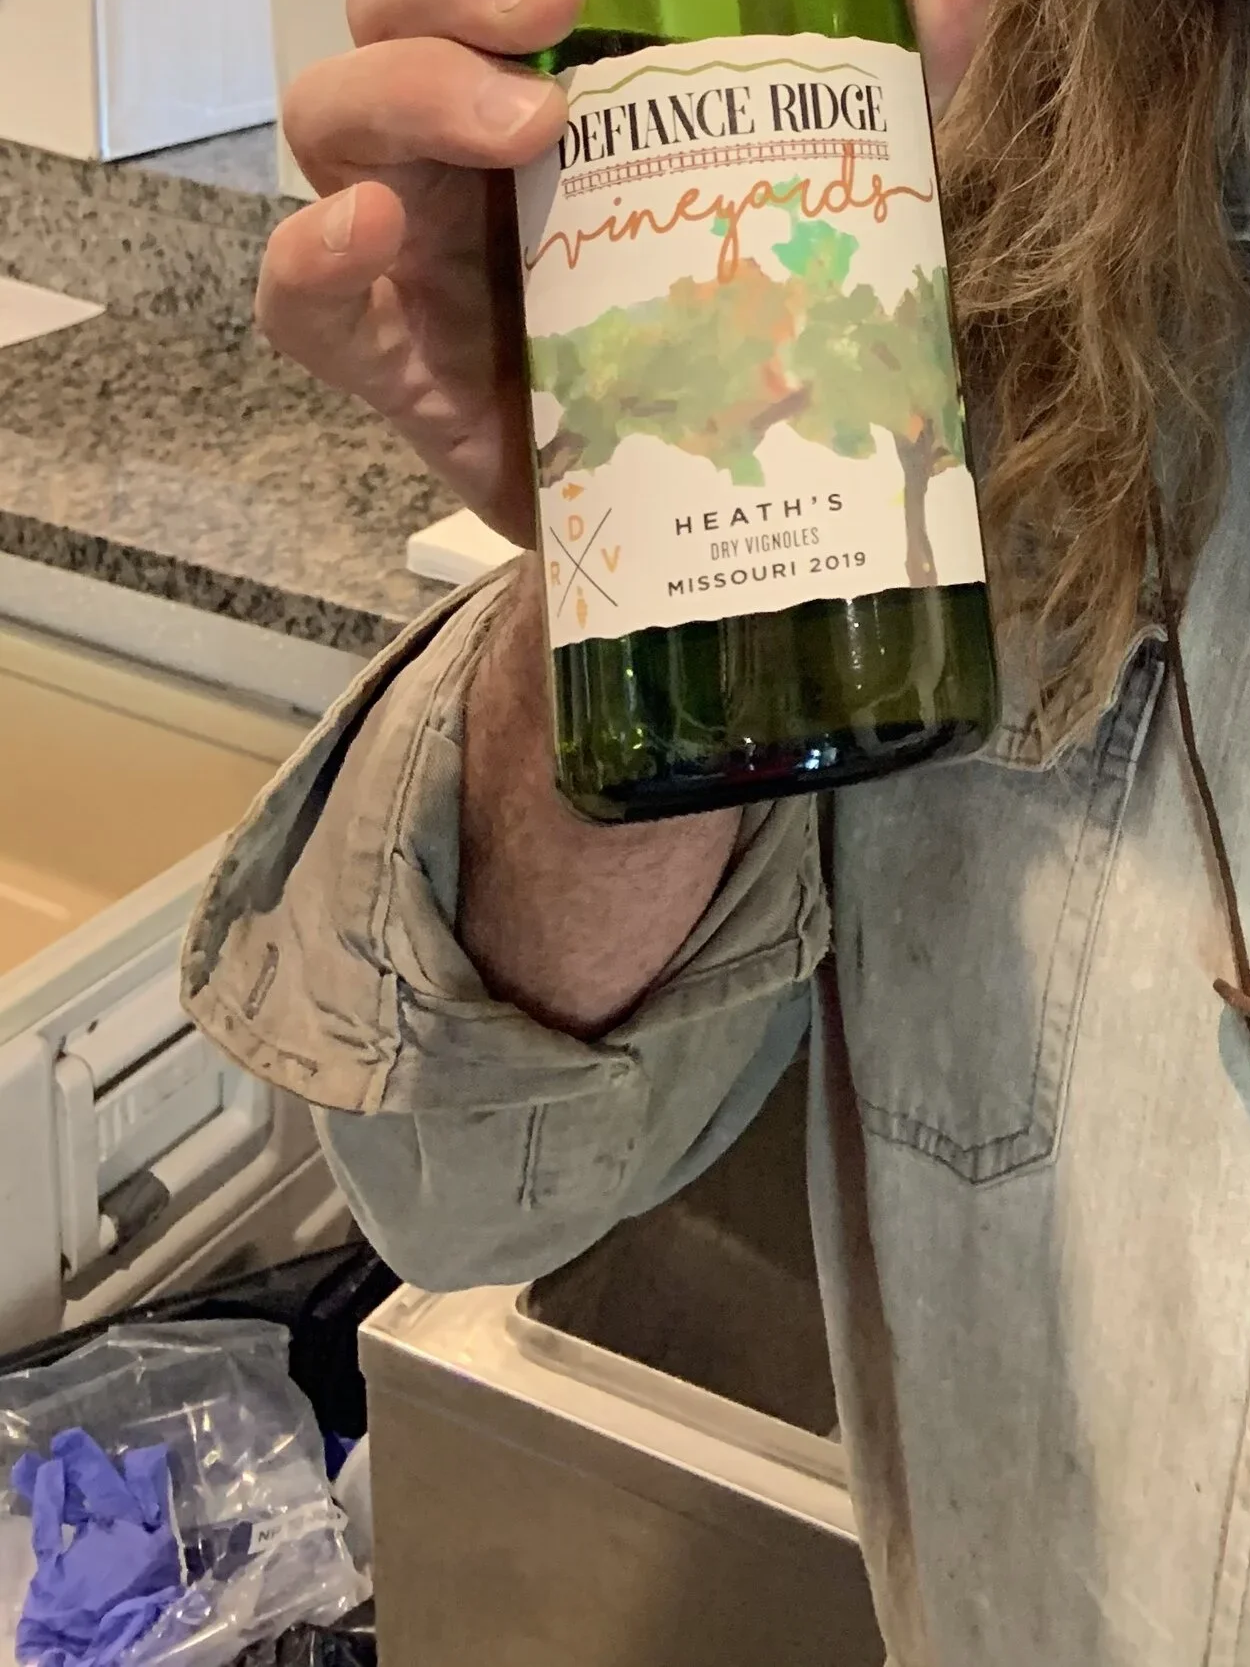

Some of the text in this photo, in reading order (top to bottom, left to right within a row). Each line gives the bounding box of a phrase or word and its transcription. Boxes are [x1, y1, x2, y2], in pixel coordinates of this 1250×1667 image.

[558, 83, 888, 171] DEFIANCE RIDGE
[524, 139, 934, 284] vineyards
[567, 514, 585, 542] D
[675, 493, 844, 536] HEATH'S
[601, 545, 621, 573] V
[710, 527, 820, 561] DRY VIGNOLES
[667, 551, 867, 597] MISSOURI 2019
